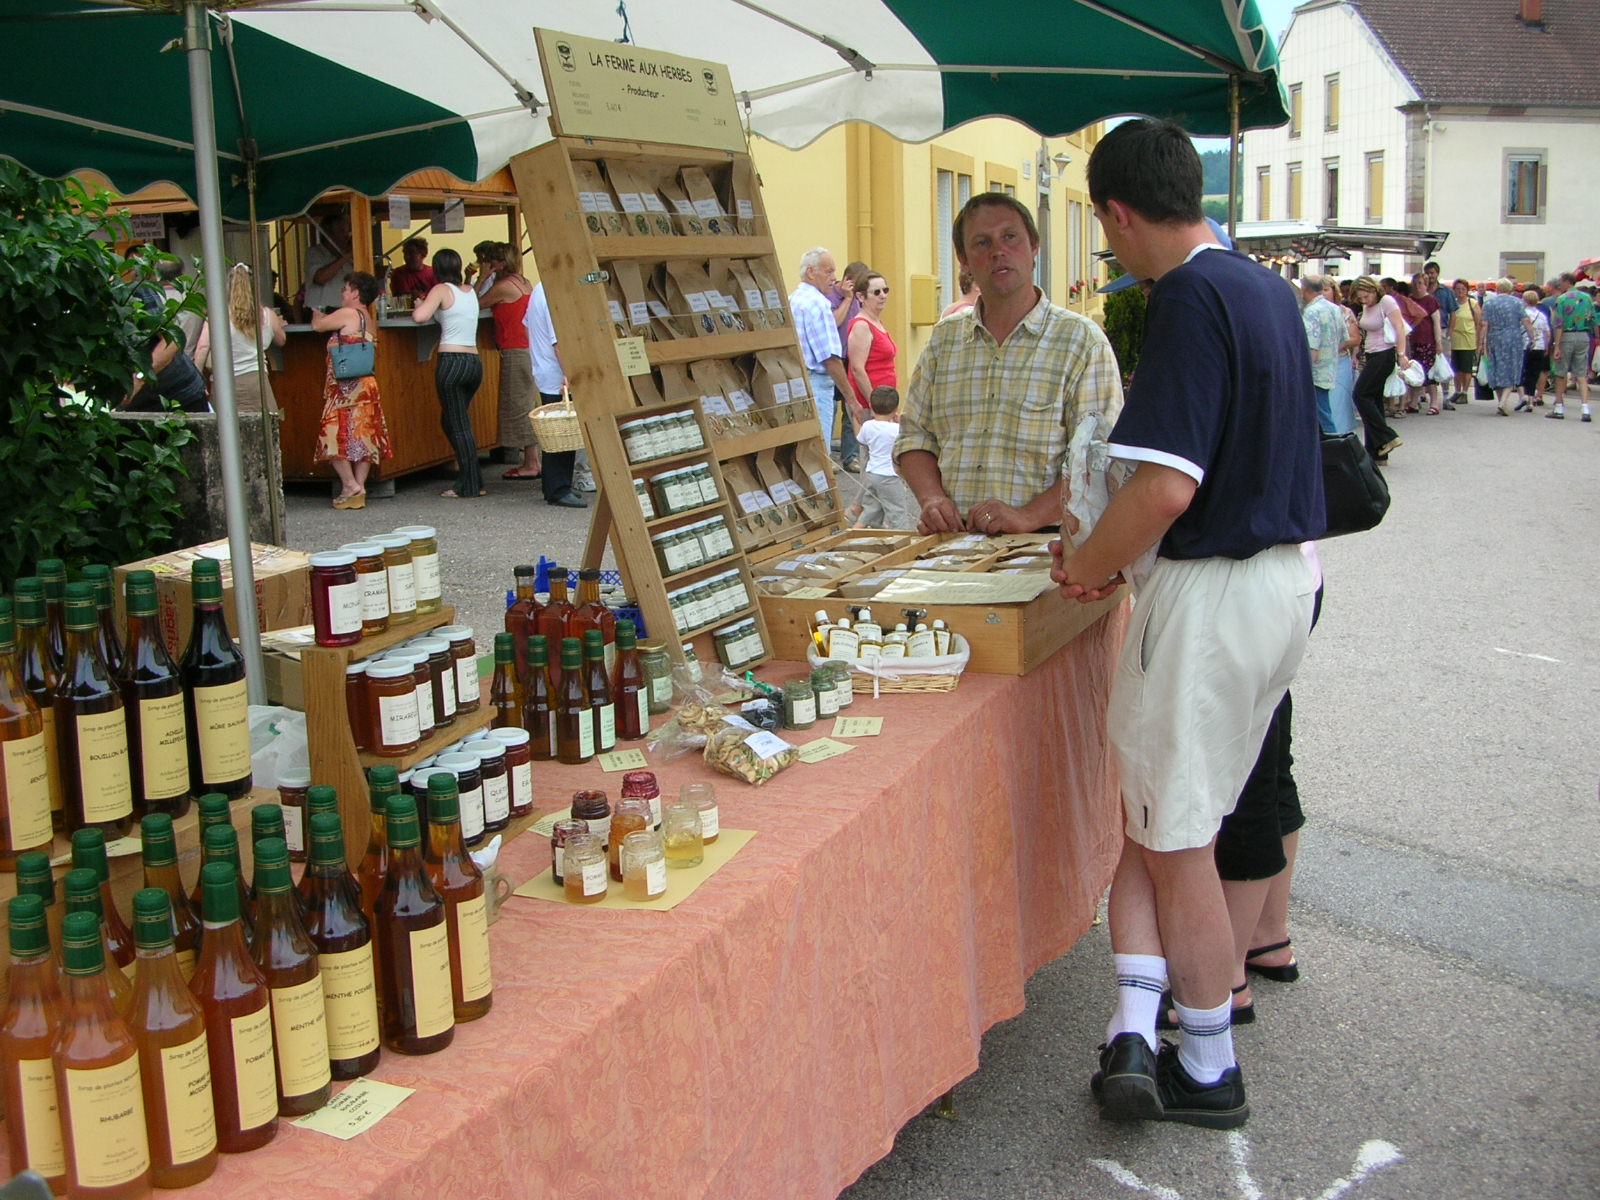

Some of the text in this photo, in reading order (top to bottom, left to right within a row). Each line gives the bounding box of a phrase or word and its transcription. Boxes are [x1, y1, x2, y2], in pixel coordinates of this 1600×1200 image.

[589, 52, 693, 83] LA FERME AUX HERBES
[627, 84, 659, 99] Producteur
[291, 1018, 315, 1031] MENTHE
[246, 1051, 265, 1064] POMME
[188, 1075, 206, 1088] POMME
[100, 1107, 134, 1123] RHUBARBE
